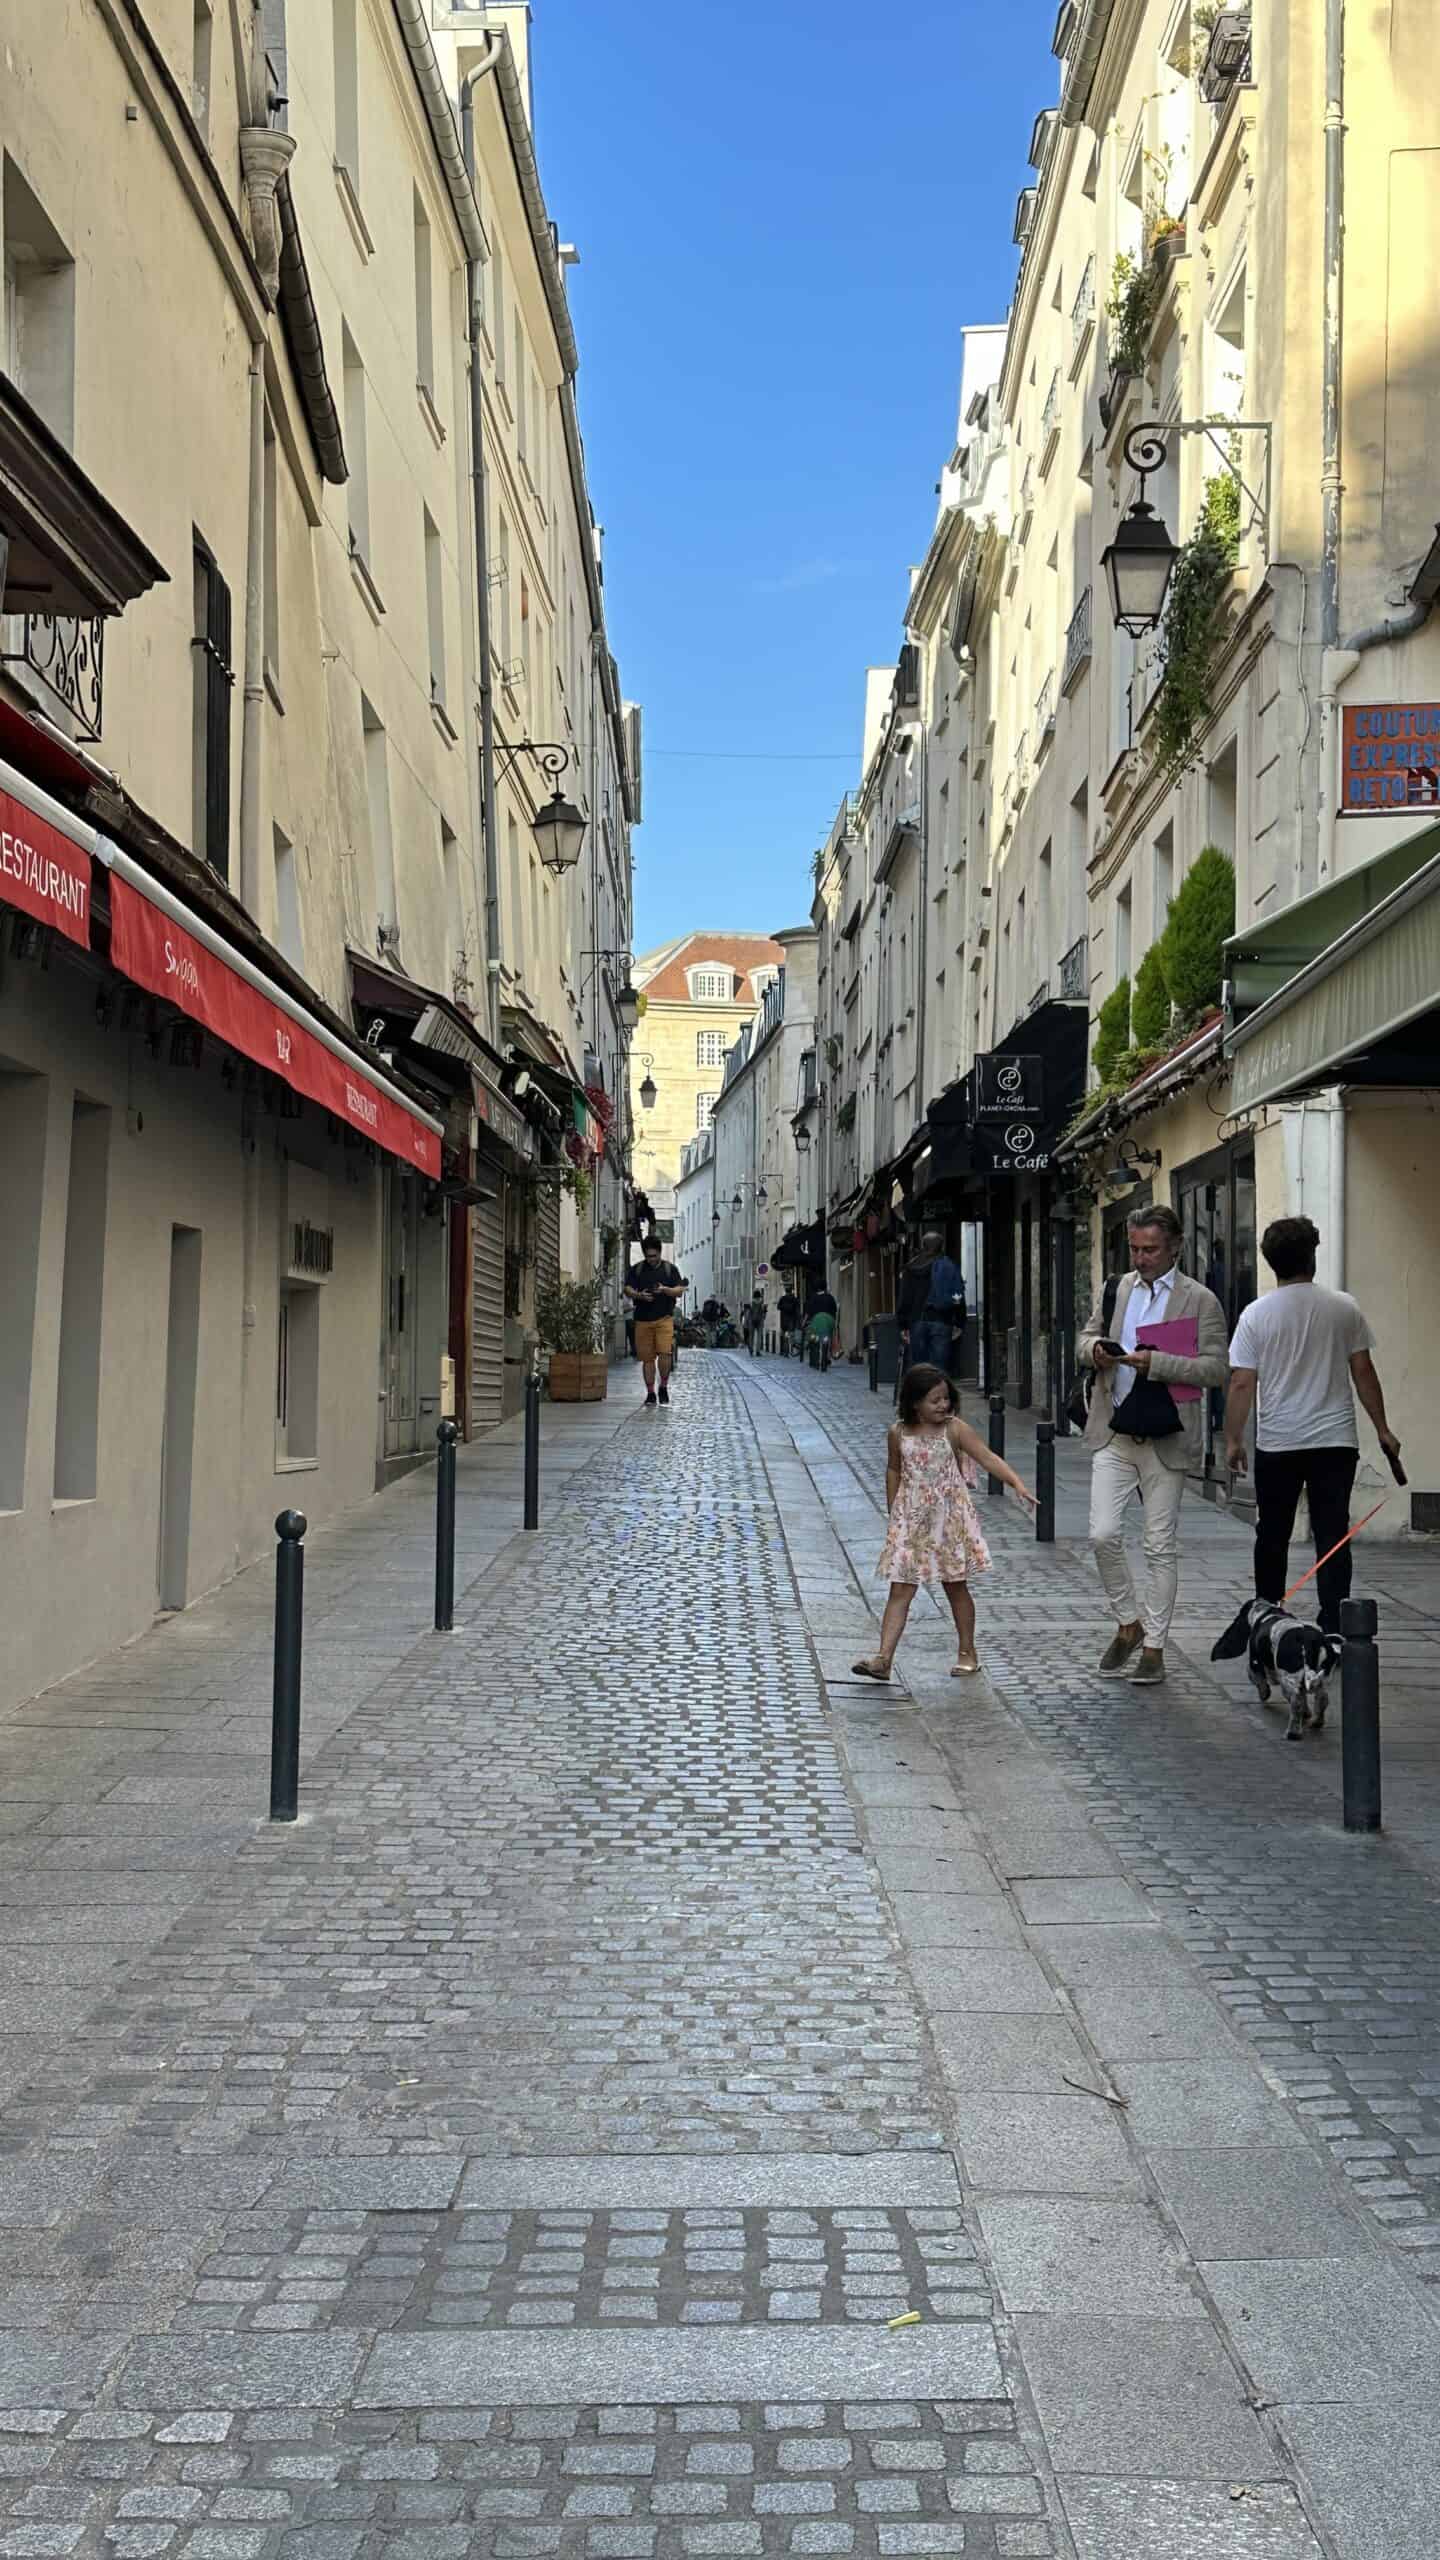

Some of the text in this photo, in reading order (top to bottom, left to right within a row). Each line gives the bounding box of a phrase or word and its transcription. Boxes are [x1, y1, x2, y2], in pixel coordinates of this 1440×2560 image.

[0, 831, 87, 919] ESTAURANT
[993, 1153, 1049, 1172] Le Café
